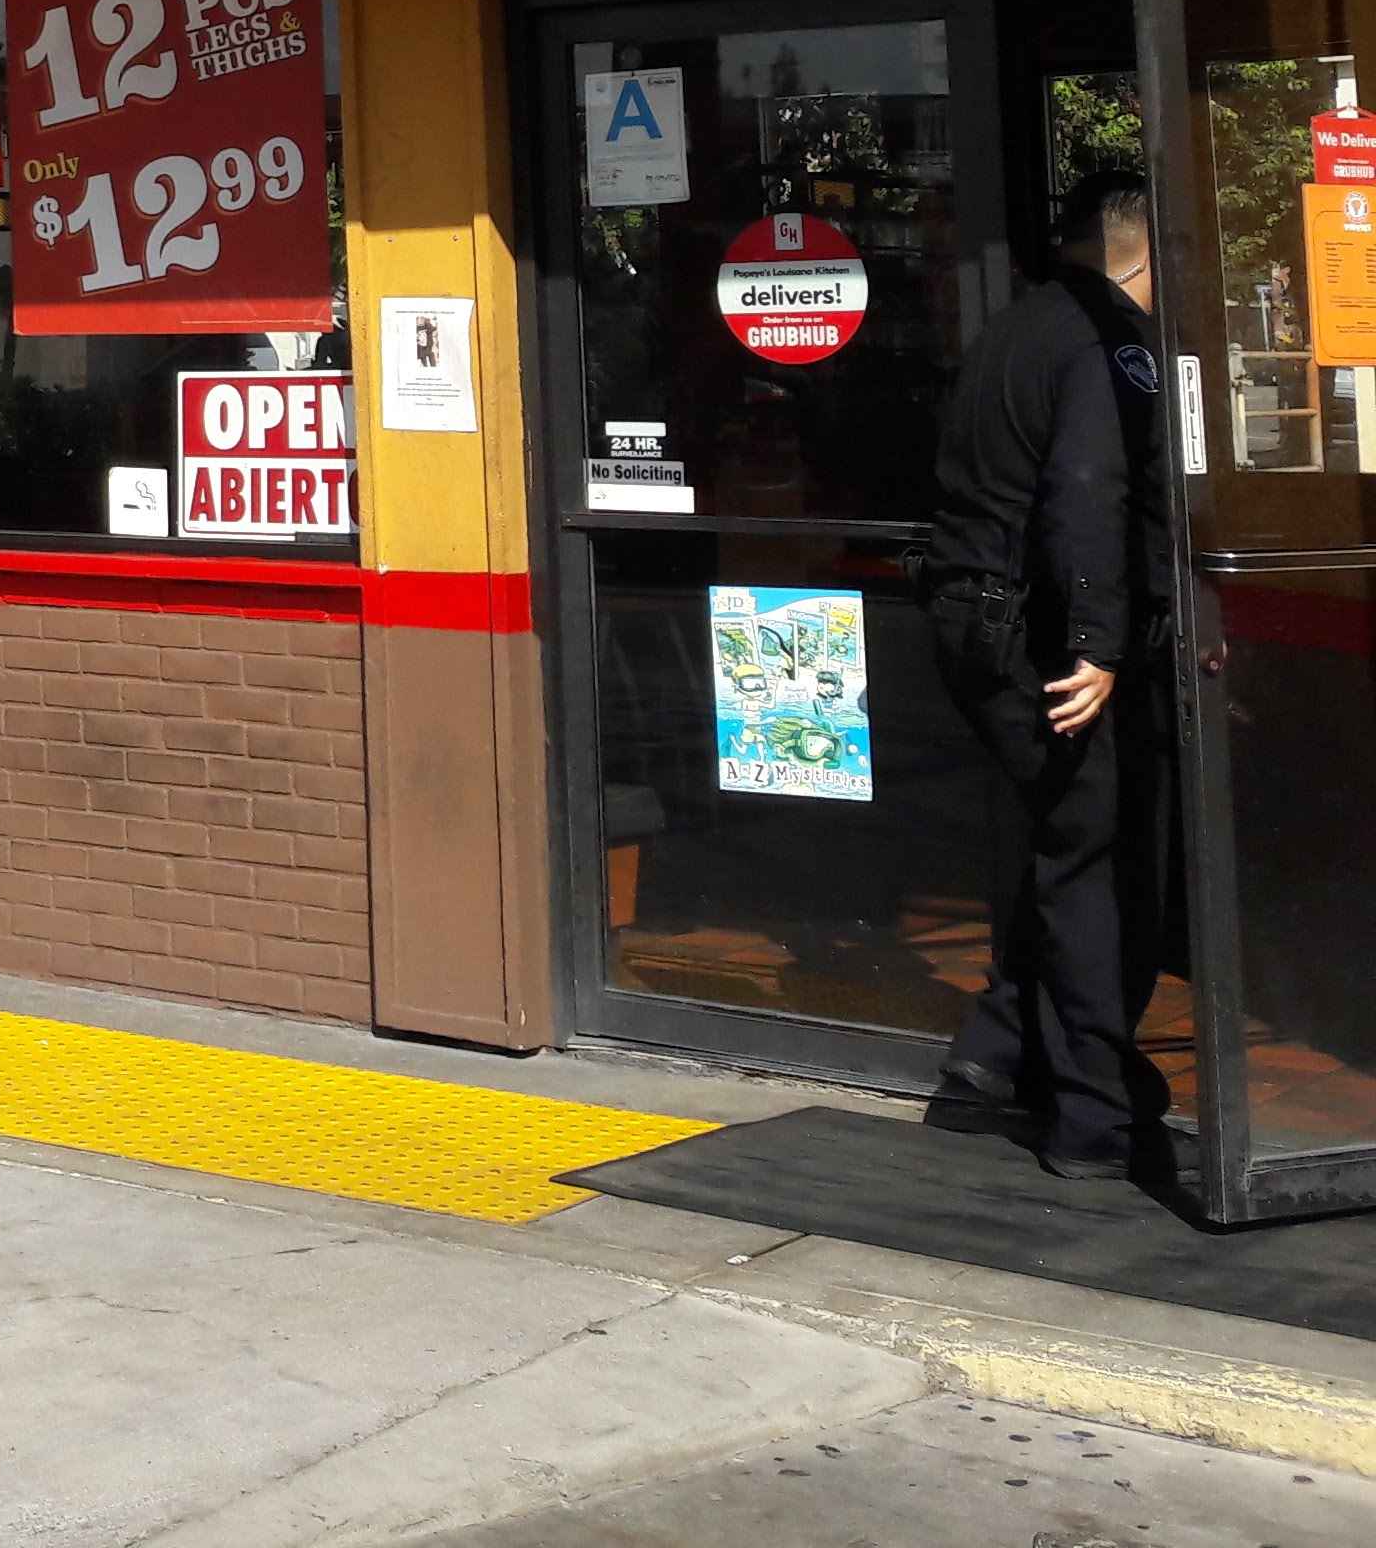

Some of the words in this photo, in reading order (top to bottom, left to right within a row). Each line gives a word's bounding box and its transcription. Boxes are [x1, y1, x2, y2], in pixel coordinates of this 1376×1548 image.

[185, 12, 271, 57] LEGS
[279, 11, 303, 33] &
[192, 31, 307, 80] THIGHS
[606, 79, 663, 142] A
[1317, 131, 1338, 147] We
[23, 152, 80, 184] Only
[814, 266, 850, 276] Kitchen
[741, 283, 842, 307] delivers!
[747, 325, 839, 348] GRUBHUB
[203, 384, 356, 451] OPEN
[1186, 366, 1199, 464] PULL
[611, 437, 631, 450] 24
[634, 437, 663, 450] HR.
[591, 463, 609, 479] No
[614, 464, 682, 485] Soliciting
[727, 761, 739, 780] A
[754, 763, 765, 782] Z
